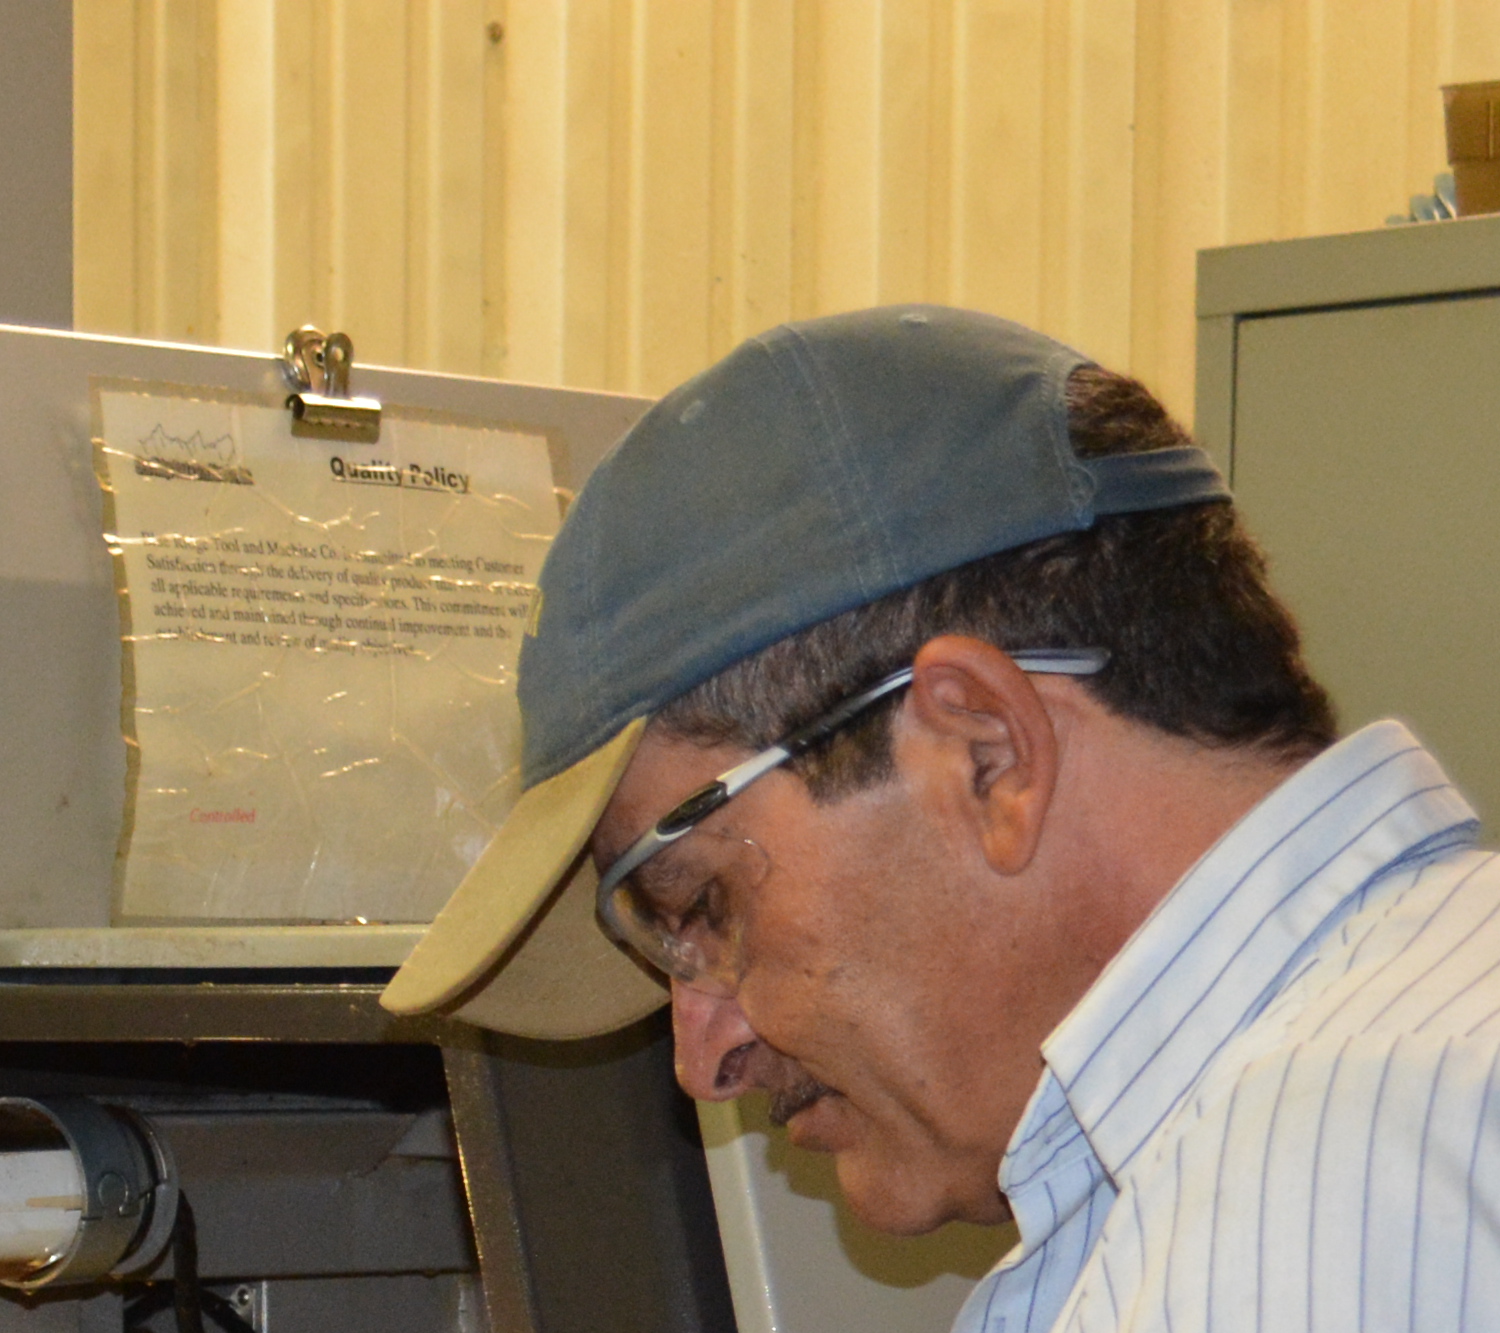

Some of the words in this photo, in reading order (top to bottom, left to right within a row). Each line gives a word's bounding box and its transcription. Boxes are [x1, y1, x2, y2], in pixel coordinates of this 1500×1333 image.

[330, 457, 403, 486] Quality
[409, 463, 470, 493] Policy
[189, 808, 256, 823] Controlled
